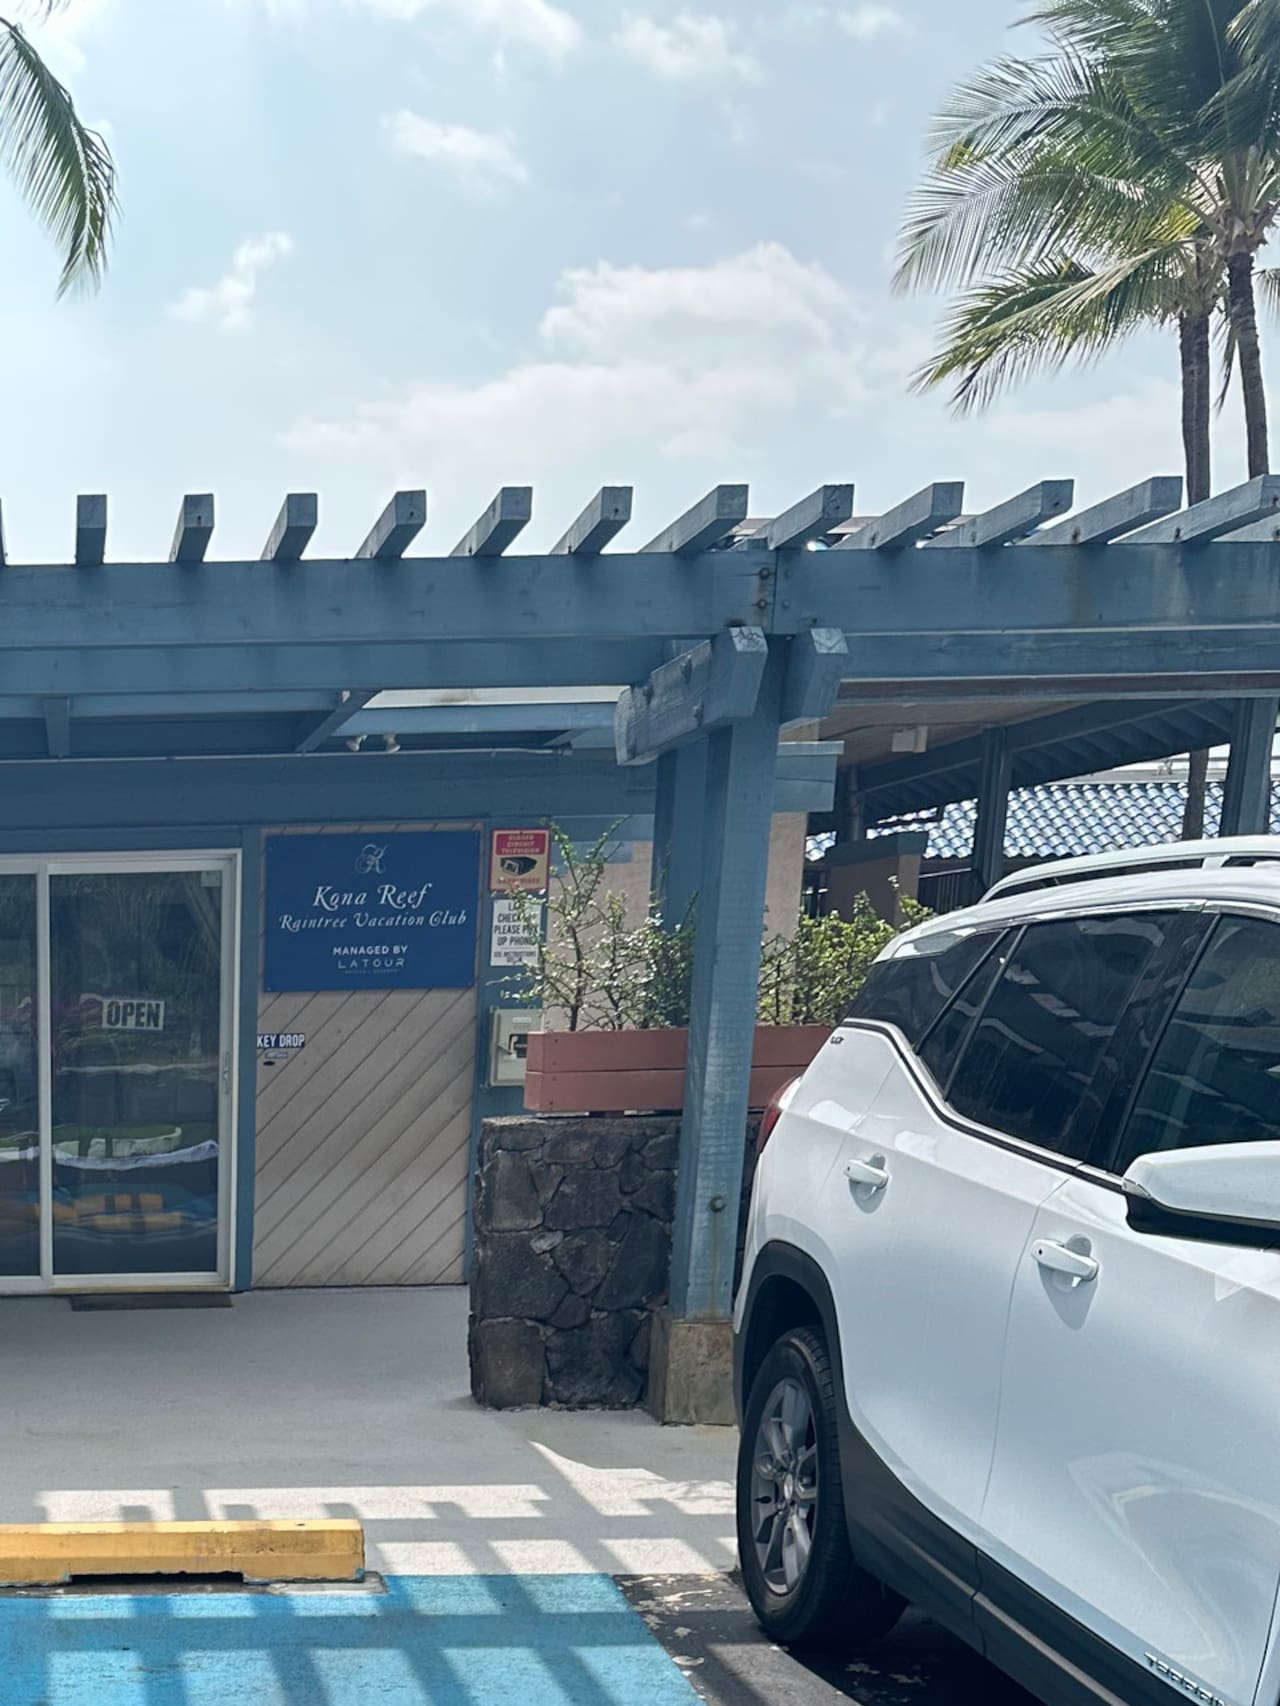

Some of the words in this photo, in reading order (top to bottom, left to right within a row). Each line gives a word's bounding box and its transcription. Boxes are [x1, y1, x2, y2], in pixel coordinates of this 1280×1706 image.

[312, 885, 367, 911] Kona
[377, 883, 432, 910] Reef
[279, 914, 347, 933] Raintree
[353, 912, 424, 928] Vacation
[428, 910, 467, 927] Club
[333, 945, 389, 956] MANAGED
[393, 944, 408, 954] BY
[338, 958, 405, 969] LATOUR
[106, 1000, 161, 1029] OPEN
[256, 1034, 277, 1048] KEY
[278, 1033, 305, 1048] DROP
